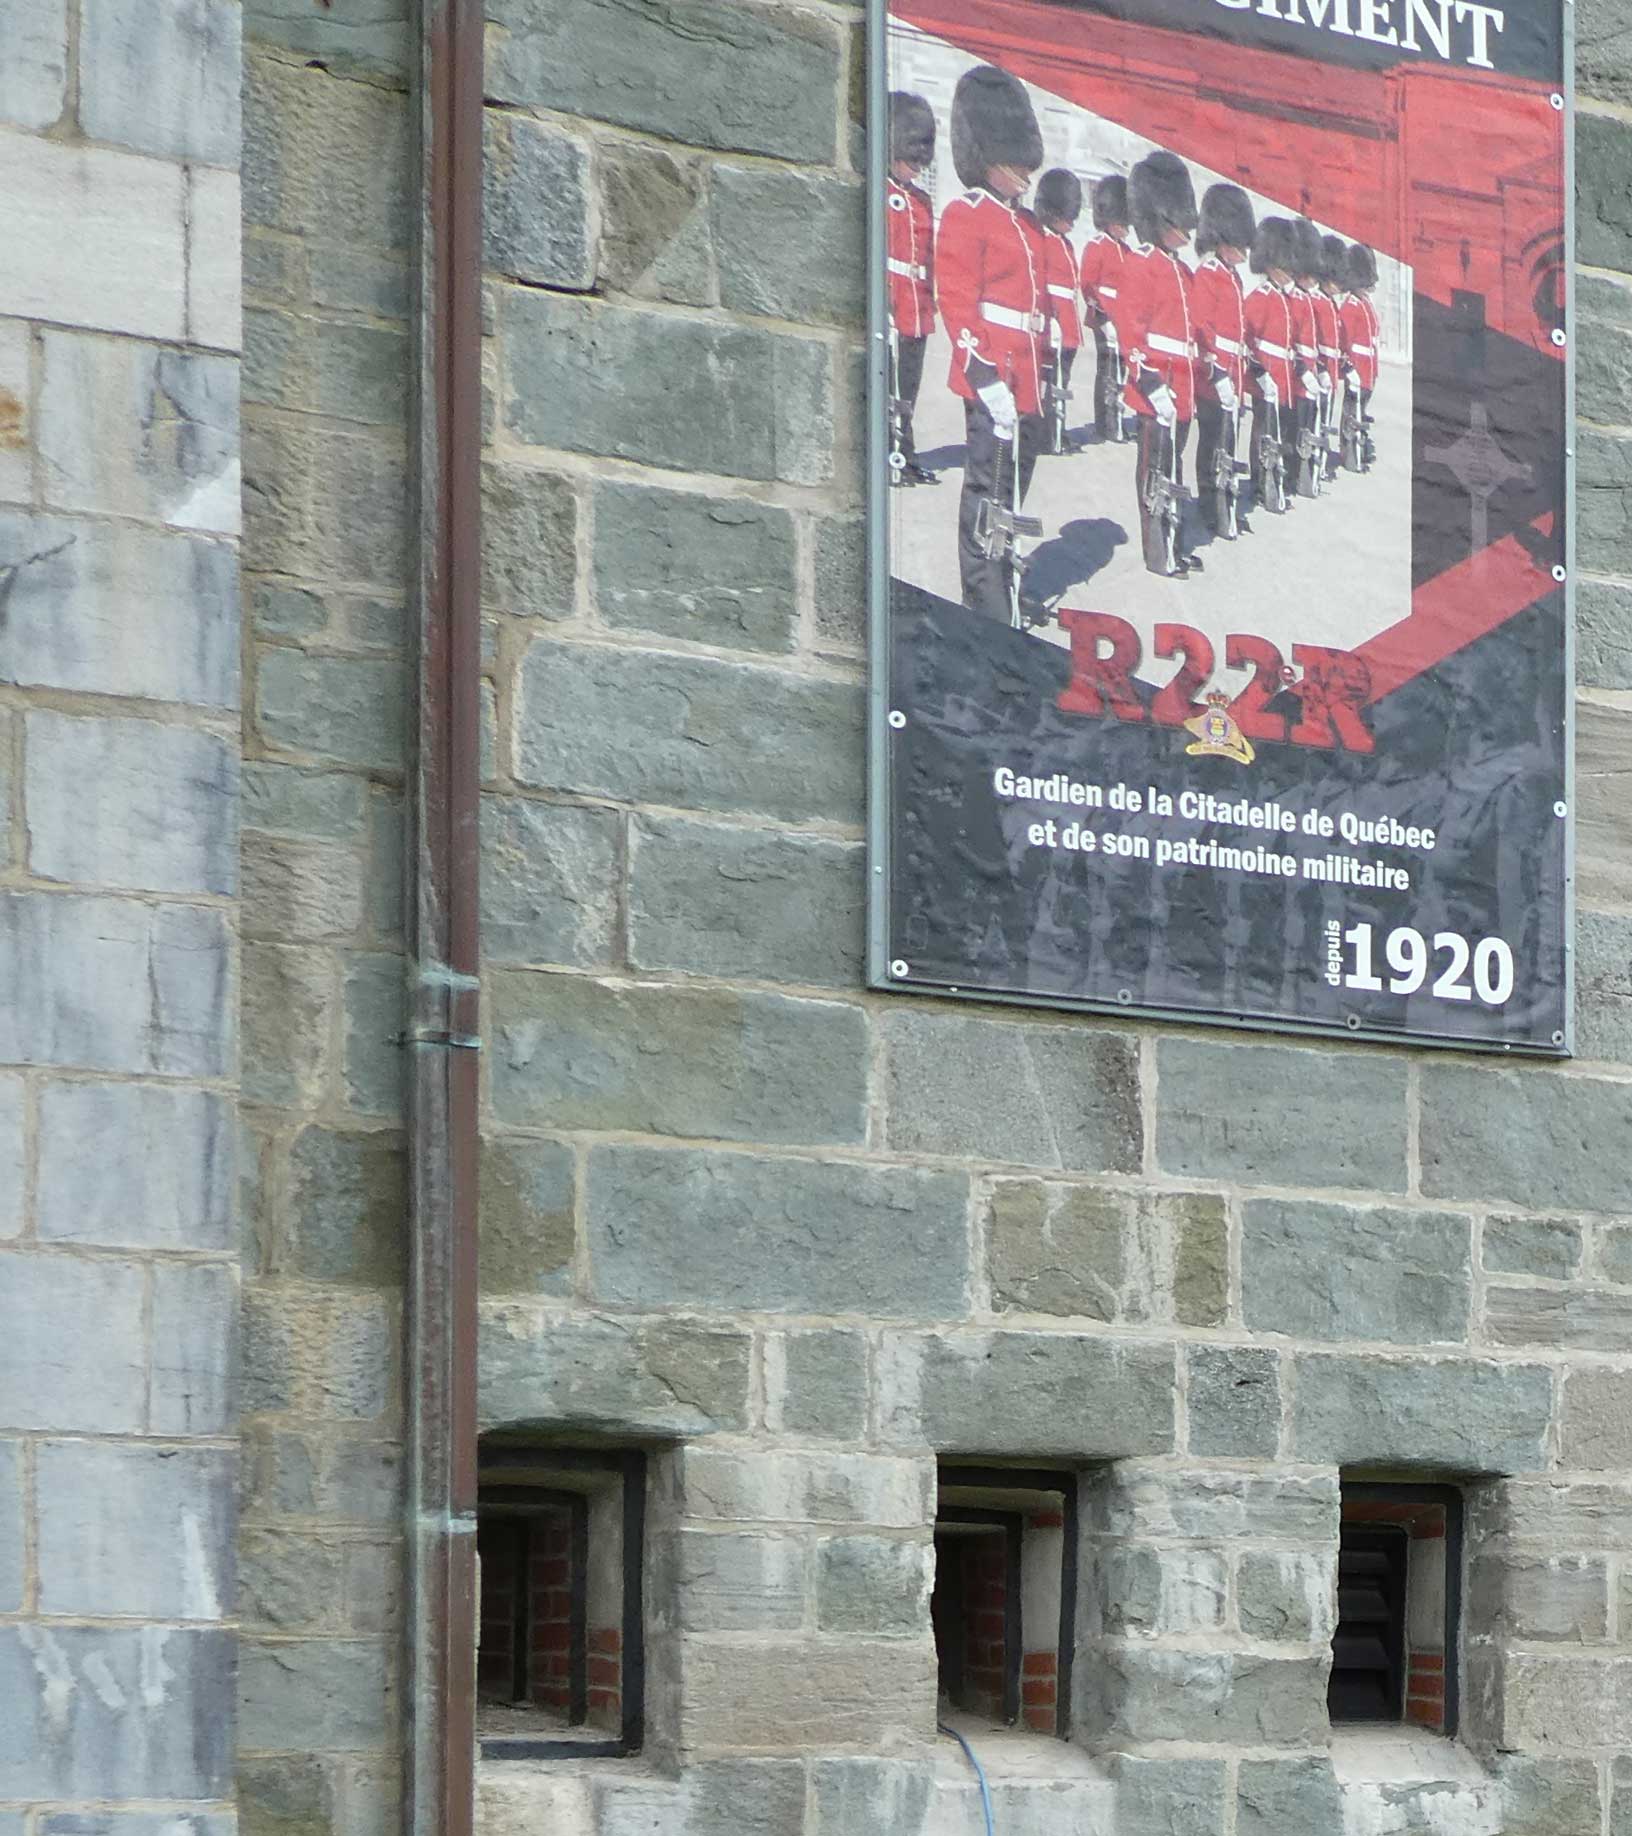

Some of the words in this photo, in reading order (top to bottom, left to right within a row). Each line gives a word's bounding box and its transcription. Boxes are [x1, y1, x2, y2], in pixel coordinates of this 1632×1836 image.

[994, 767, 1102, 807] Gardien
[1109, 783, 1142, 812] de
[1148, 787, 1173, 816] la
[1180, 791, 1296, 832] Citadelle
[1302, 808, 1334, 837] de
[1340, 813, 1435, 850] Québec
[1028, 820, 1057, 847] et
[1062, 823, 1096, 852] de
[1102, 832, 1149, 858] son
[1156, 838, 1296, 877] patrimoine
[1303, 854, 1409, 890] militaire
[1325, 920, 1343, 986] depuis
[1345, 923, 1514, 1004] 1920
